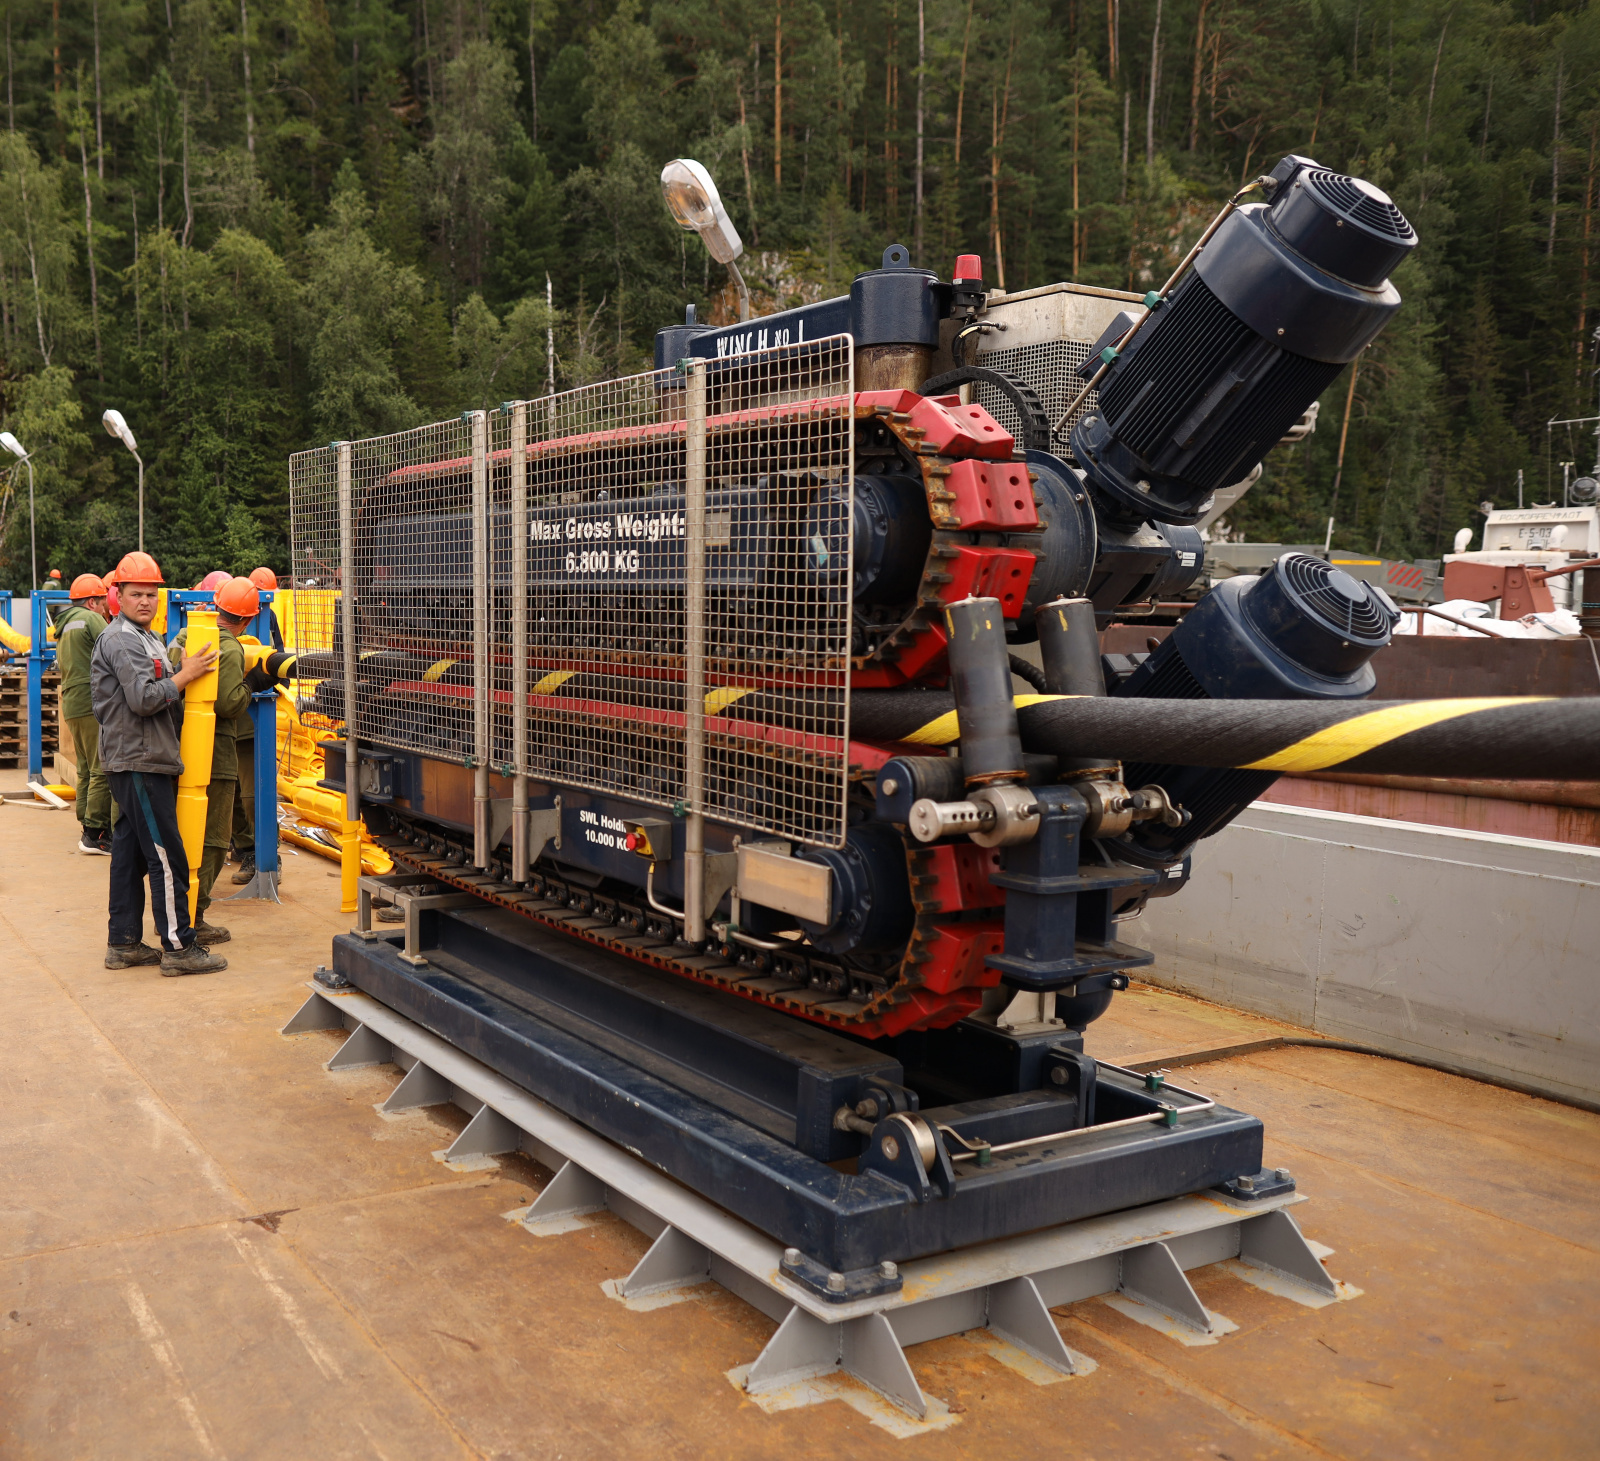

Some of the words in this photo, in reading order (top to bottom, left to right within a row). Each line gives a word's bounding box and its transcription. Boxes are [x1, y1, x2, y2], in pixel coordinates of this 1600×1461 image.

[531, 520, 561, 541] Max
[565, 517, 612, 539] Gross
[617, 512, 686, 542] Weight:
[565, 550, 610, 573] 6.800
[615, 549, 640, 573] KG
[580, 810, 598, 825] SWL
[601, 814, 627, 833] Holdi
[585, 829, 615, 847] 10.000
